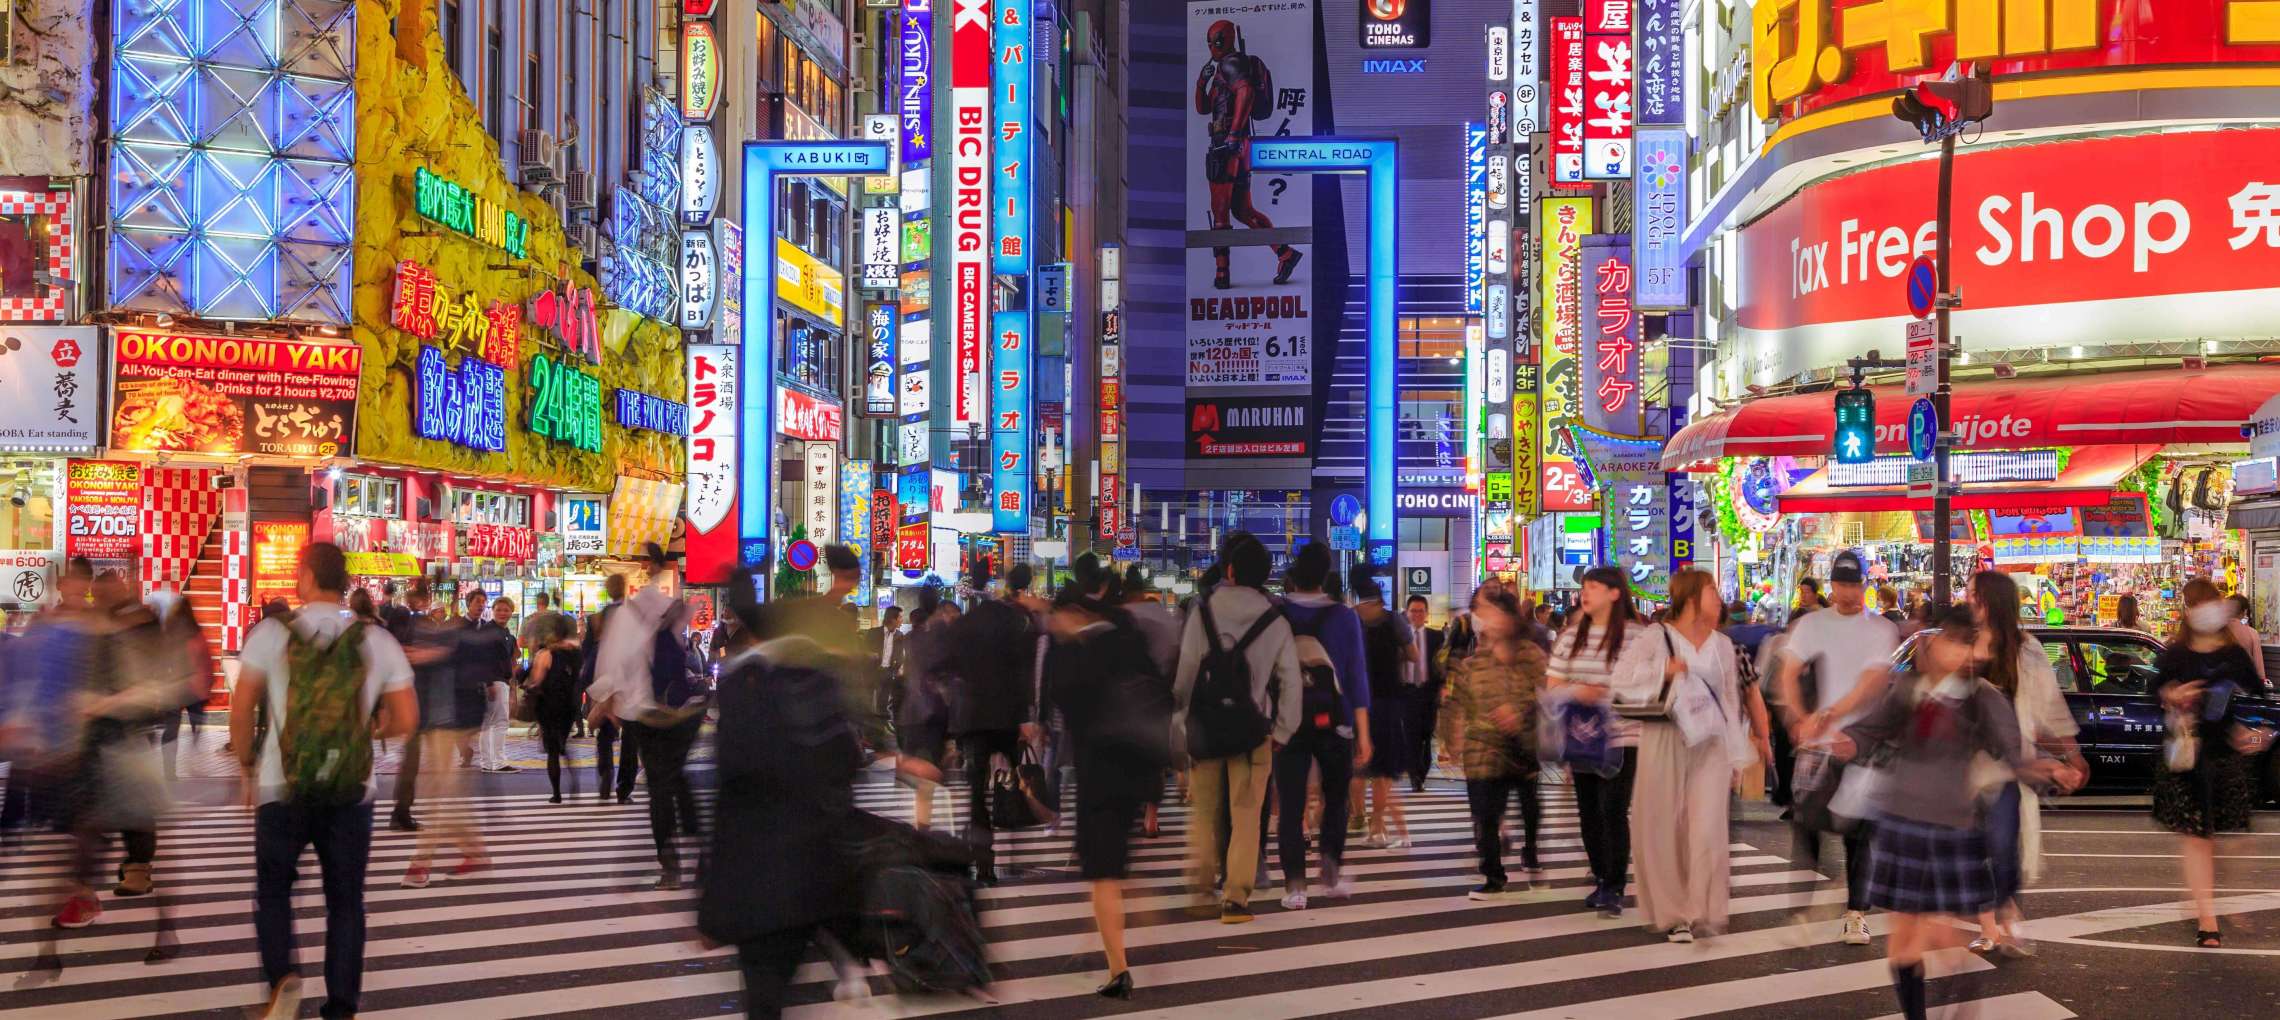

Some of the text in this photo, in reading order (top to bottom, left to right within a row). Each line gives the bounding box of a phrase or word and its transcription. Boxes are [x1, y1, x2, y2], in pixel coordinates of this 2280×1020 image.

[1367, 24, 1401, 35] TOHO
[1367, 35, 1414, 45] CINEMAS
[1363, 60, 1424, 73] IMAX
[1493, 36, 1503, 76] 東京ビル
[903, 31, 923, 131] SHINJUKU
[1258, 148, 1373, 160] CENTRAL ROAD
[874, 178, 891, 190] 3F
[958, 106, 982, 253] BIC DRUG
[688, 211, 704, 222] 1F
[1648, 192, 1662, 249] STAGE
[1662, 192, 1676, 240] IDOL
[685, 239, 706, 249] 新宿
[1791, 236, 1830, 299] Tax
[1840, 218, 1953, 285] Free
[1976, 191, 2191, 273] Shop
[685, 250, 707, 304] かっぱ
[963, 267, 975, 289] BIC
[1648, 267, 1674, 285] 5F
[688, 311, 704, 321] B1
[1190, 295, 1308, 321] DEADPOOL
[962, 292, 975, 350] CAMERA
[1224, 322, 1272, 330] デッドプール
[871, 309, 890, 358] 海の家
[1597, 258, 1634, 414] カラオケ
[121, 334, 360, 371] OKONOMI YAKI
[1265, 335, 1297, 358] 6.1
[121, 364, 356, 388] All-You-Can-Eat dinner with Free-Flowing
[719, 348, 735, 411] 大衆酒場
[1516, 365, 1536, 377] 4F
[215, 383, 356, 399] Drinks for 2 hours ¥2,700
[1516, 378, 1536, 390] 3F
[54, 371, 78, 424] 蕎麦
[531, 353, 602, 453] 24時間
[693, 355, 717, 462] トラノコ
[1000, 330, 1021, 510] カラオケ館
[1226, 406, 1304, 427] MARUHAN
[0, 429, 88, 440] OBA Eat standing
[1875, 413, 2032, 446] on uijote
[1913, 413, 1925, 451] P
[321, 445, 335, 454] 2F
[69, 481, 138, 490] OKONOMI YAKI
[1546, 466, 1577, 491] 2F
[813, 480, 827, 538] 珈琲茶館
[1397, 494, 1438, 508] TOHO
[566, 539, 604, 551] 虎の子
[900, 541, 925, 550] アダム
[1629, 485, 1655, 583] カラオケ
[1674, 540, 1694, 557] B
[2100, 755, 2126, 764] TAXI
